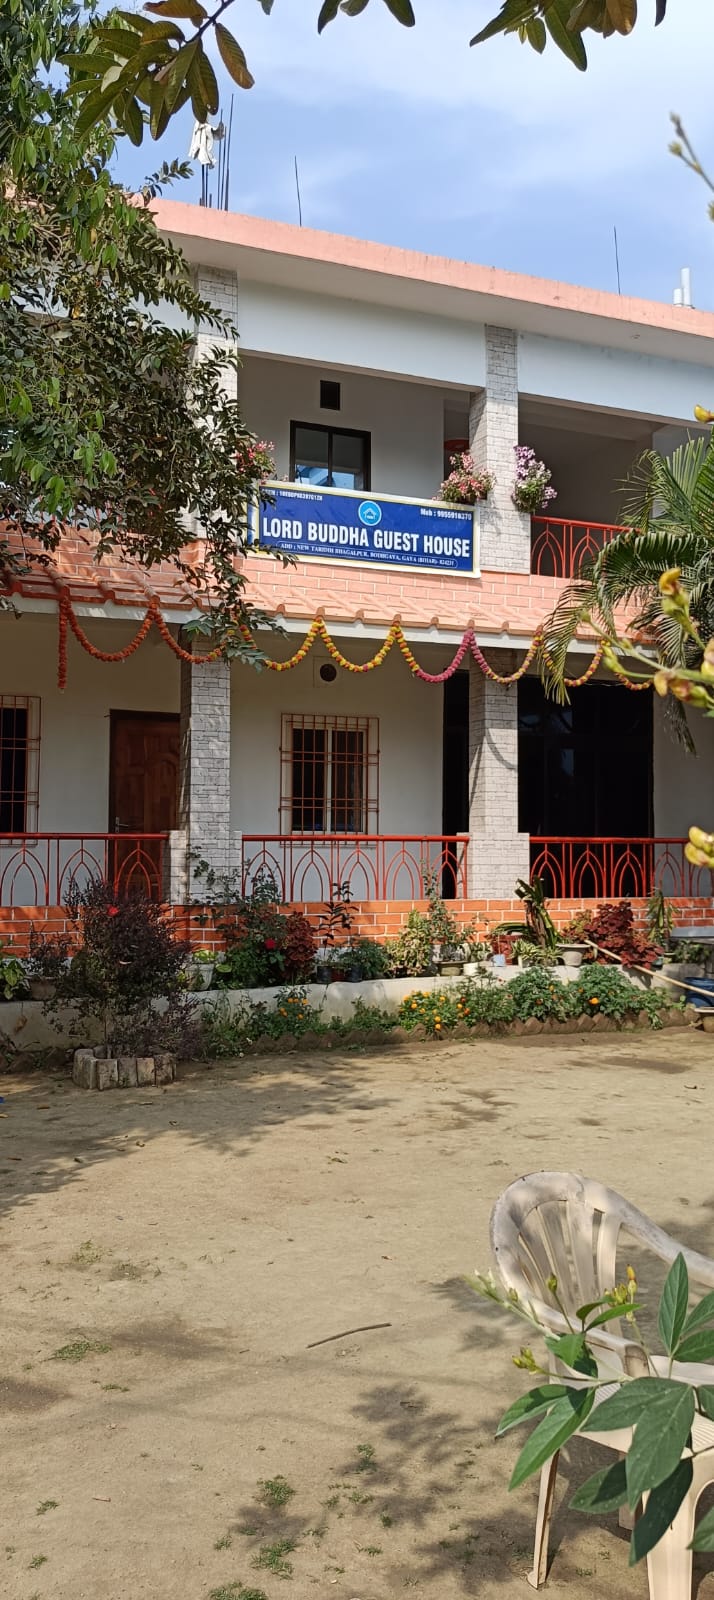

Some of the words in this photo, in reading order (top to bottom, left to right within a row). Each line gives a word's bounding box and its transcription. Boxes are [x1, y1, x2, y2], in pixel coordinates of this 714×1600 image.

[420, 508, 433, 516] Mob
[263, 517, 303, 540] LORD
[307, 522, 369, 547] BUDDHA
[373, 529, 420, 552] GUEST
[423, 535, 470, 558] HOUSE
